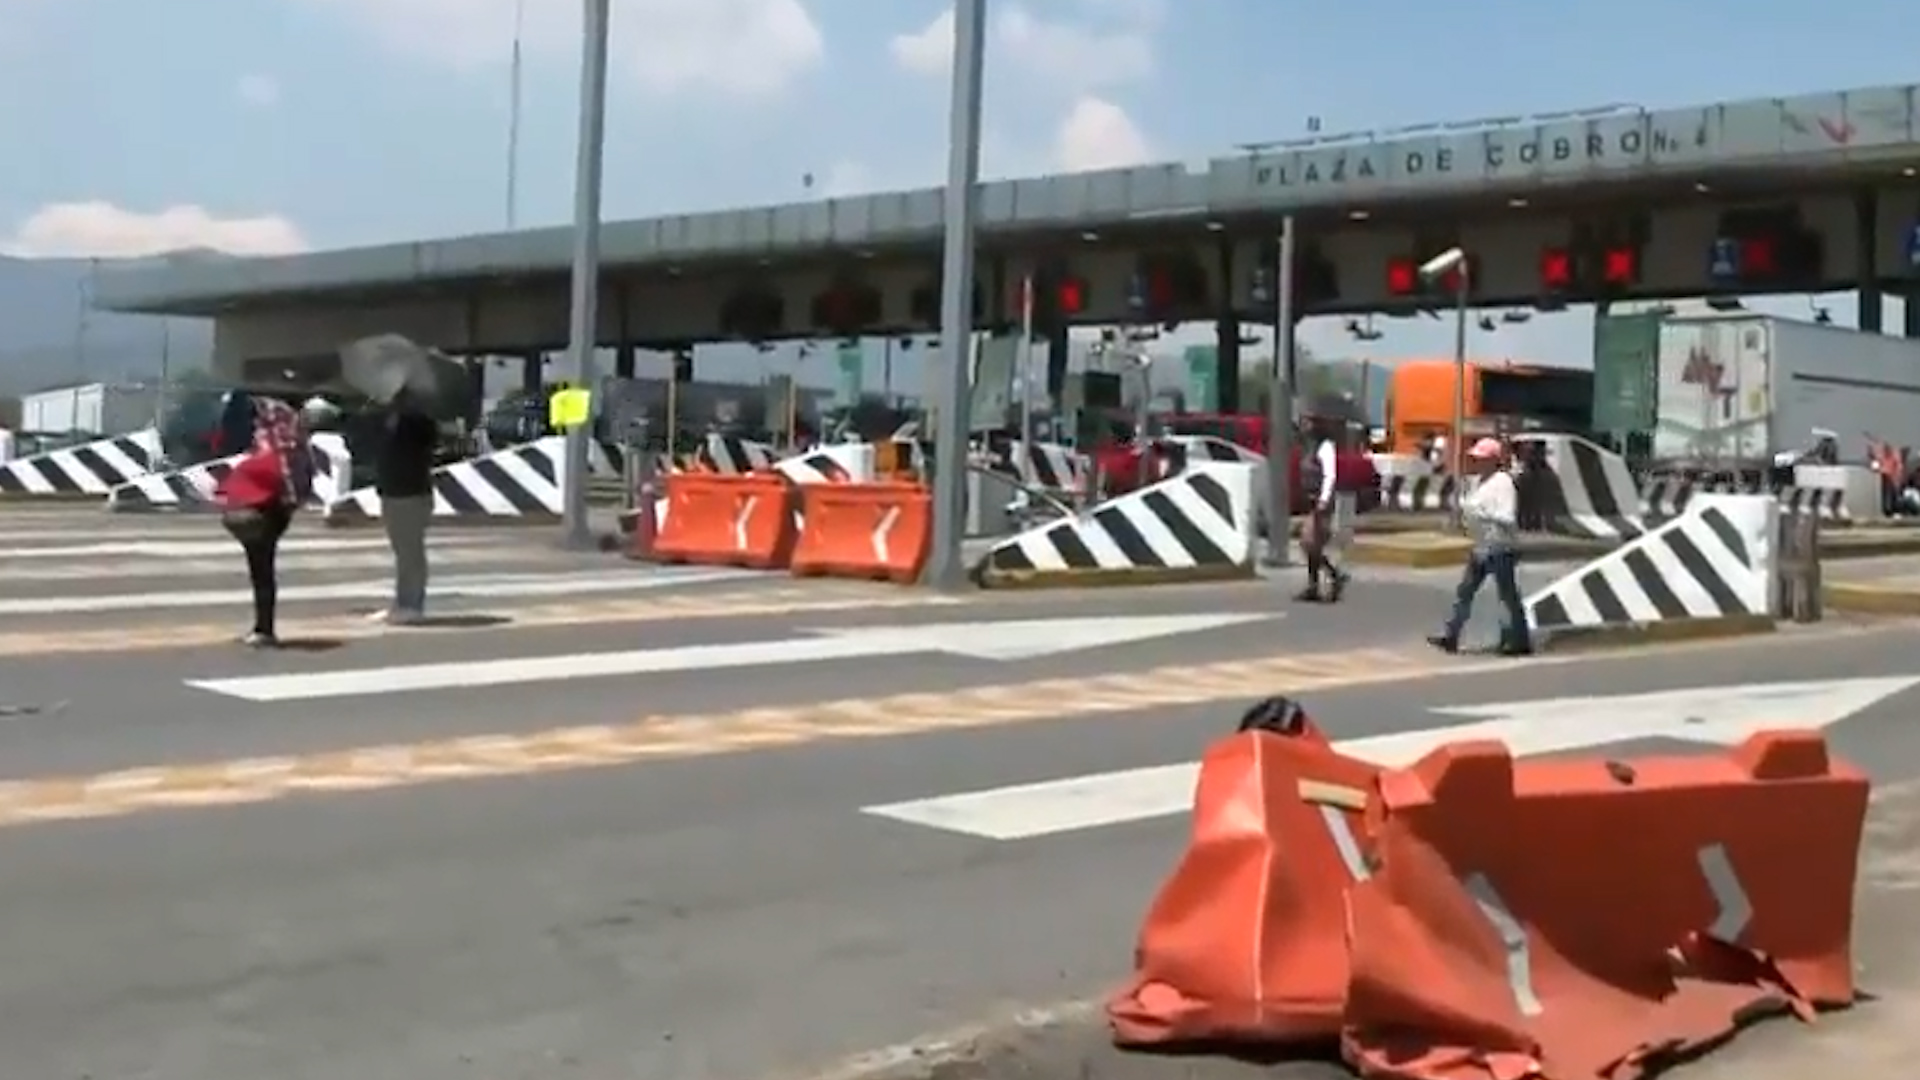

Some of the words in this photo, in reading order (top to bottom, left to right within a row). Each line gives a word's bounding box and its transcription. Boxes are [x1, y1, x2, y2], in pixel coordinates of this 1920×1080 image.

[1256, 155, 1376, 186] PLAZA
[1405, 148, 1453, 174] DE
[1486, 127, 1641, 168] COBRO
